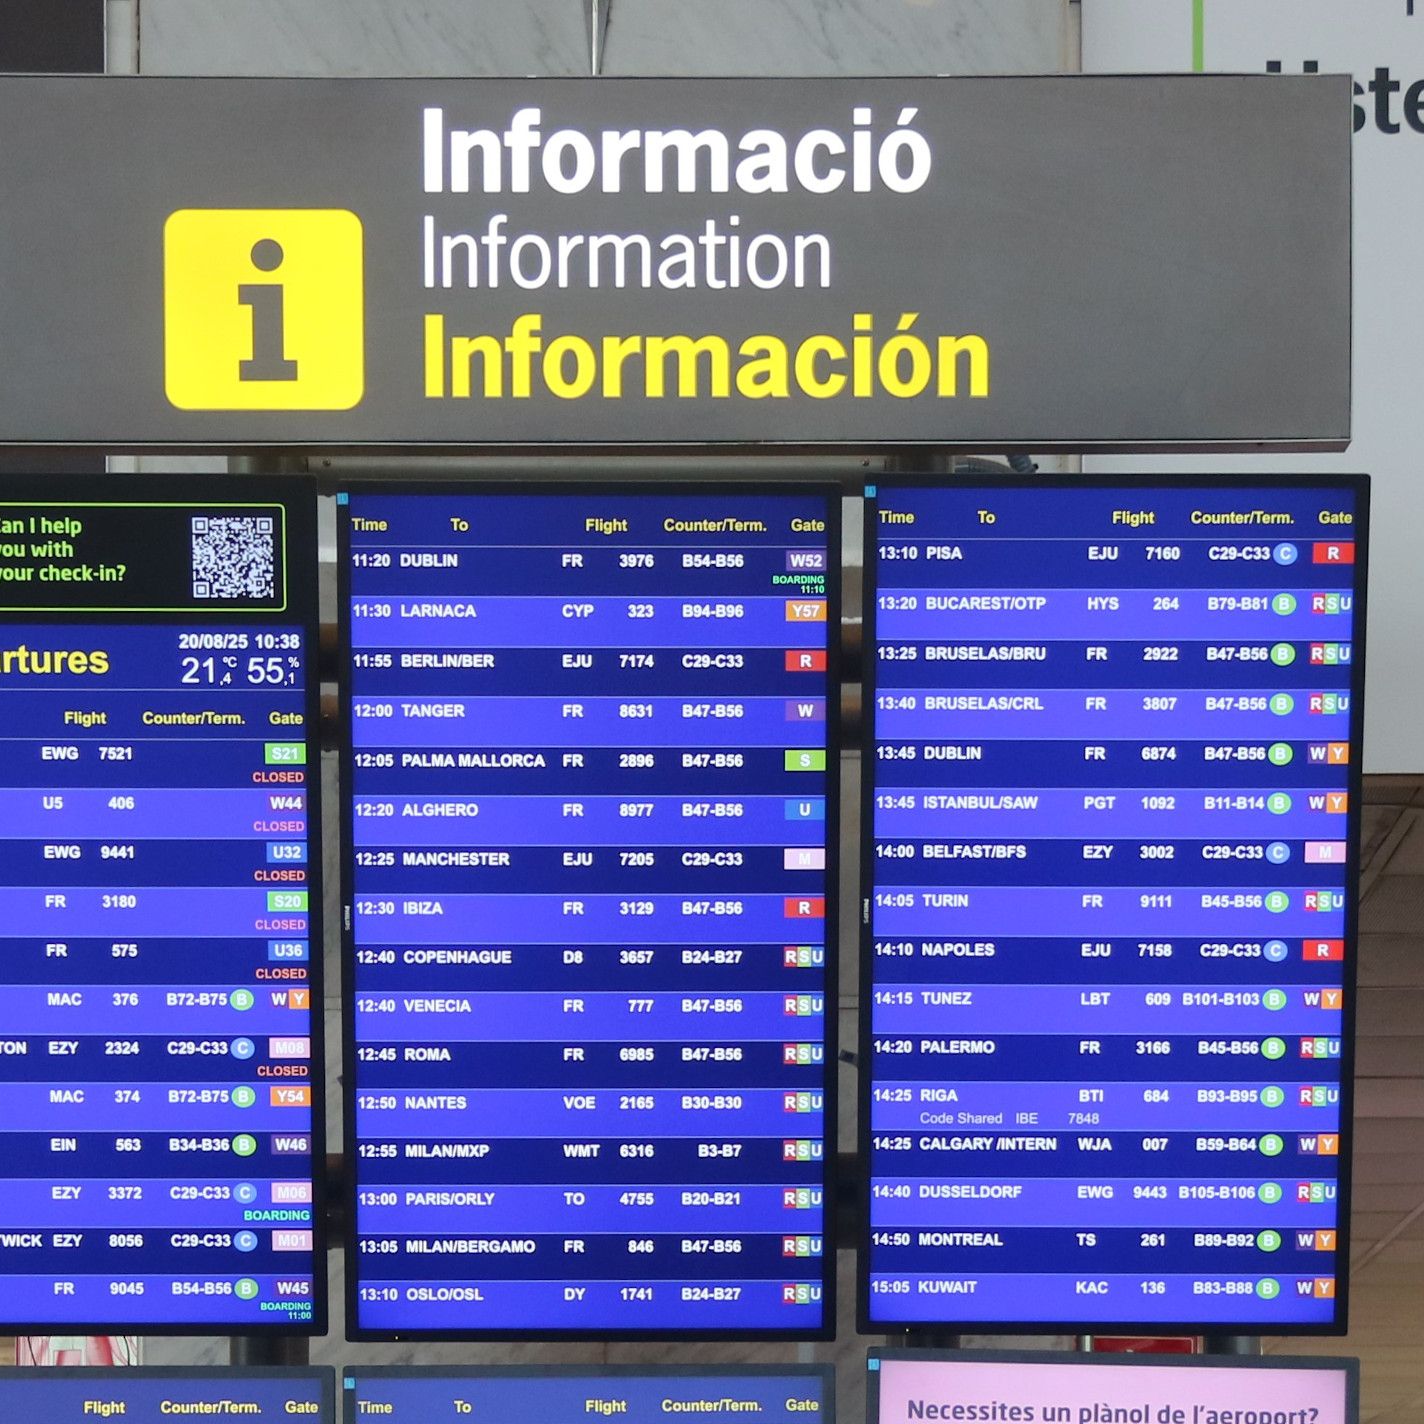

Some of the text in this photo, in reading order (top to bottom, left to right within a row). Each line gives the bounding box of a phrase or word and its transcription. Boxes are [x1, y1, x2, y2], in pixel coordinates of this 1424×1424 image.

[424, 108, 931, 193] Informació
[425, 214, 829, 289] Information
[425, 314, 988, 398] Información
[30, 518, 35, 533] I
[41, 517, 81, 537] help
[31, 541, 73, 557] with
[879, 546, 917, 559] 13:10
[927, 546, 962, 559] PISA
[1089, 547, 1118, 559] EJU
[1146, 547, 1180, 560] 7160
[1209, 547, 1270, 560] C29-C33
[1328, 548, 1338, 559] R
[353, 554, 822, 567] 11:20 DUBLIN FR 3976 B54-B56 W52
[40, 565, 125, 581] check-in?
[179, 634, 300, 649] 20/08/25 10:38
[354, 654, 812, 668] 11:55 BERLIN/BER EJU 7174 C29-C33 R
[65, 711, 106, 727] Flight
[143, 712, 245, 724] Counter/Term.
[269, 712, 303, 724] Gate
[42, 747, 78, 759] EWG
[99, 747, 131, 760] 7521
[271, 747, 298, 760] S21
[253, 772, 304, 782] CLOSED
[50, 1090, 84, 1103] MAC
[115, 1090, 140, 1102] 374
[169, 1090, 229, 1102] B72-B75
[277, 1091, 304, 1103] Y54
[920, 1112, 1099, 1124] Code Shared IBE 7848
[908, 1400, 1034, 1421] Necessites
[1043, 1407, 1070, 1422] un
[1158, 1405, 1185, 1424] de
